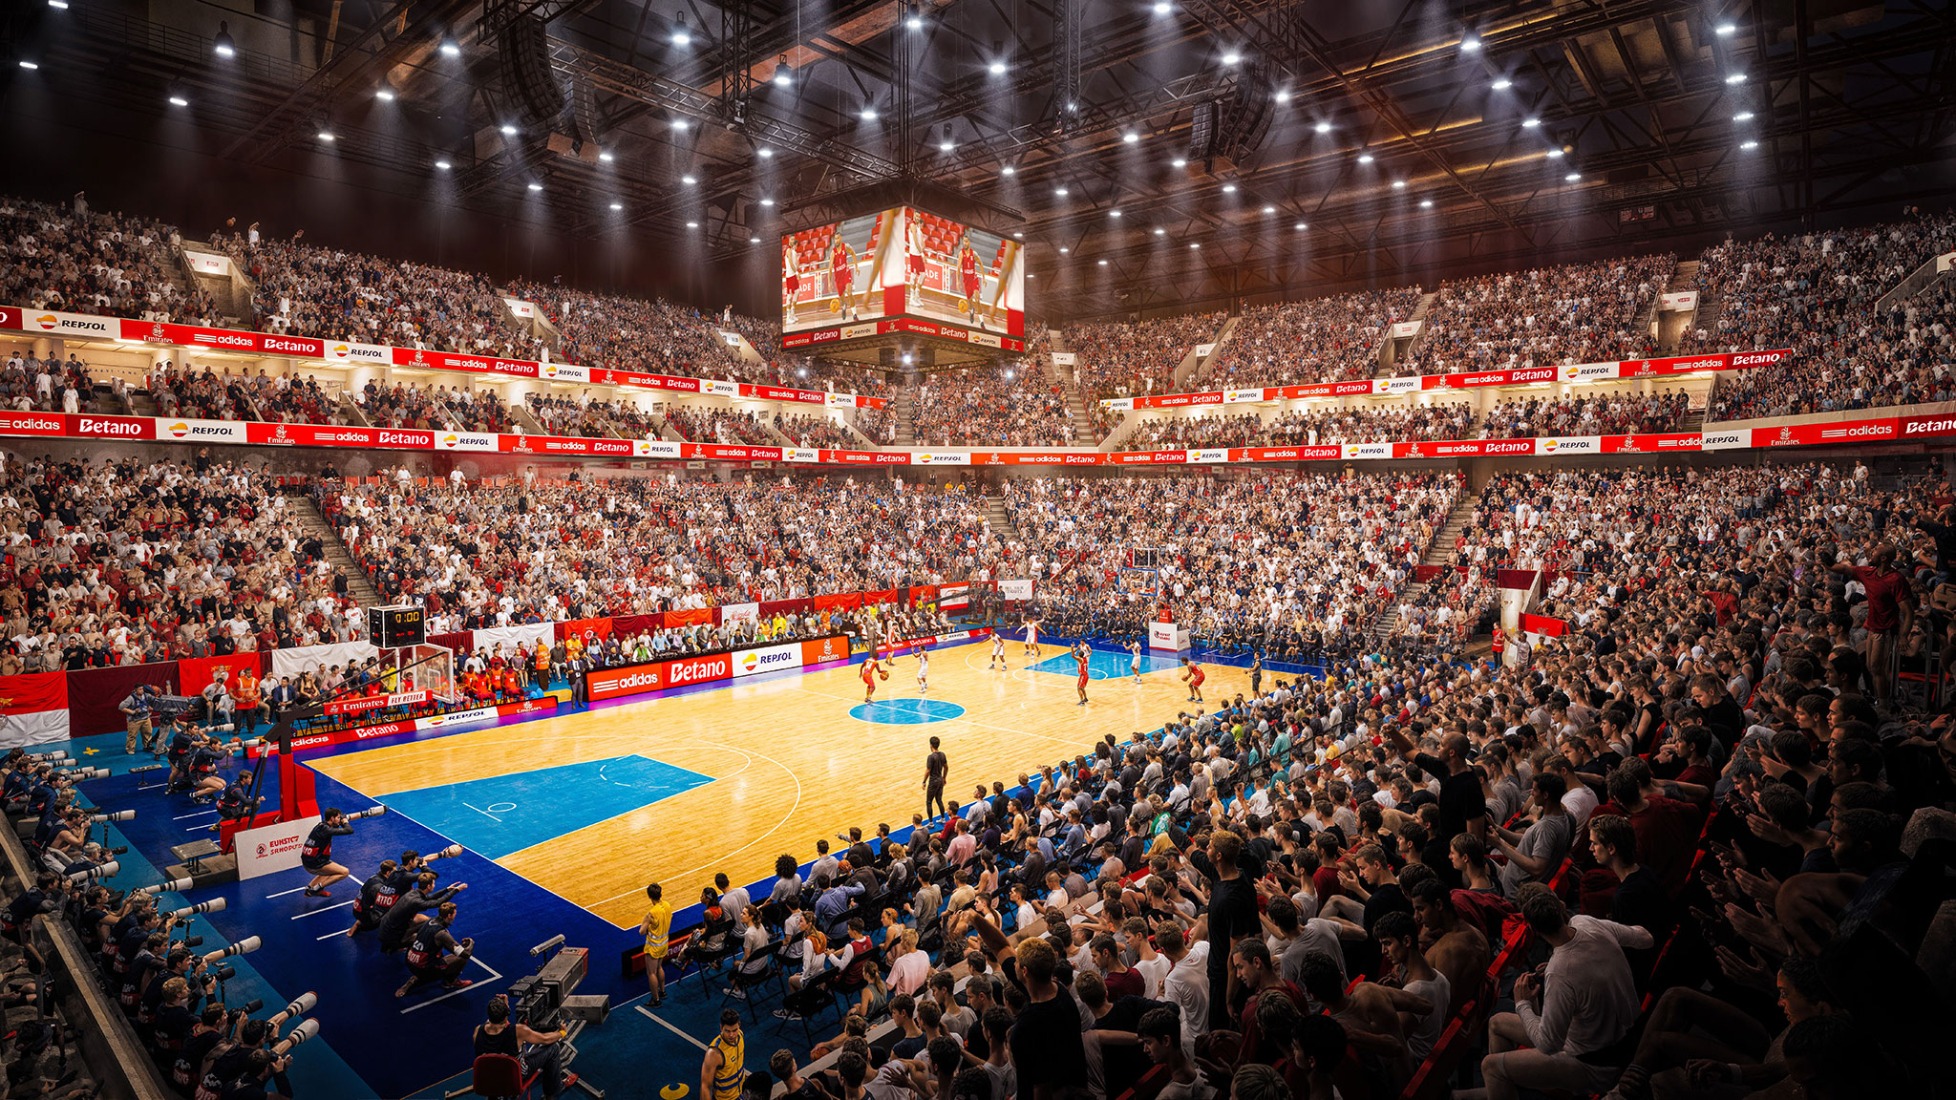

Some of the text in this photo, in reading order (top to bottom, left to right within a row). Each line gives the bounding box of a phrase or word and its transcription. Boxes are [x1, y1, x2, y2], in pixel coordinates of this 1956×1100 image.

[62, 319, 107, 331] REPSOL
[940, 327, 967, 338] Betano
[217, 335, 253, 347] adidas
[264, 338, 316, 353] Betano
[351, 348, 383, 358] REPSOL
[1692, 359, 1723, 368] adidas
[1732, 353, 1780, 366] Betano
[461, 360, 488, 370] adidas
[495, 361, 534, 373] Betano
[558, 369, 583, 377] REPSOL
[1512, 369, 1553, 381] Betano
[1581, 367, 1609, 376] REPSOL
[641, 377, 661, 386] adidas
[667, 379, 695, 389] Betano
[1479, 374, 1504, 384] adidas
[1336, 383, 1367, 393] Betano
[1390, 381, 1414, 389] REPSOL
[1310, 387, 1330, 395] adidas
[799, 392, 822, 401] Betano
[1192, 394, 1220, 404] Betano
[12, 419, 60, 430] adidas
[79, 418, 141, 435] Betano
[192, 426, 234, 436] REPSOL
[1848, 424, 1893, 436] adidas
[336, 432, 369, 442] adidas
[379, 432, 429, 445] Betano
[459, 438, 490, 446] REPSOL
[1705, 436, 1740, 444] REPSOL
[561, 441, 586, 450] adidas
[594, 442, 629, 452] Betano
[1453, 444, 1478, 452] adidas
[1485, 442, 1529, 453] Betano
[1560, 441, 1590, 450] REPSOL
[728, 449, 746, 457] adidas
[751, 449, 778, 459] Betano
[1154, 453, 1184, 461] Betano
[1276, 450, 1297, 458] adidas
[1304, 448, 1337, 457] Betano
[876, 454, 906, 463] Betano
[1066, 455, 1095, 463] Betano
[760, 651, 793, 664] REPSOL
[817, 652, 840, 663] Emirates
[670, 659, 726, 683] Betano
[619, 672, 659, 689] adidas
[343, 699, 385, 711] Emirates
[391, 696, 402, 704] FLY
[448, 711, 486, 721] REPSOL
[355, 723, 399, 738] Betano
